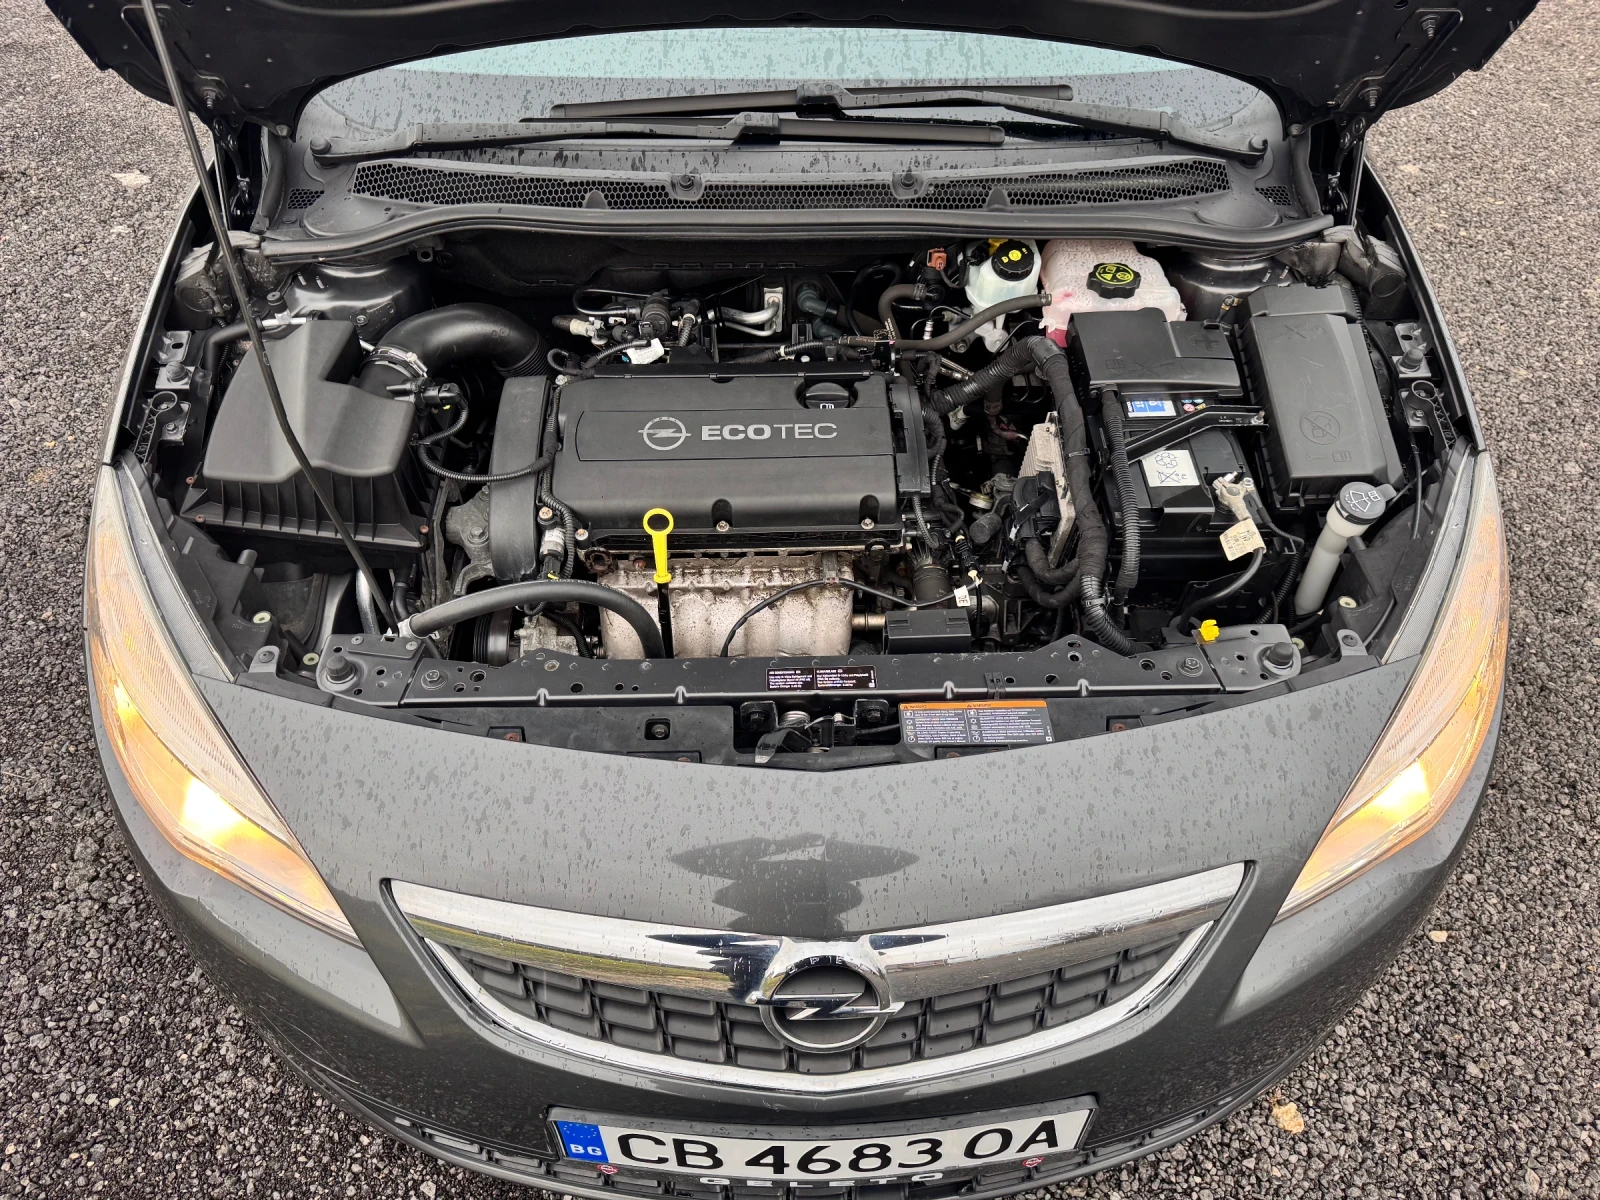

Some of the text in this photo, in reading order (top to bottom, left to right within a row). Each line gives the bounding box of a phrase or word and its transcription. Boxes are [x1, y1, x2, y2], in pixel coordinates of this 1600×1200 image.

[701, 422, 838, 441] ECOTEC
[569, 1143, 602, 1156] BG
[617, 1119, 1059, 1175] CB 4683 OA
